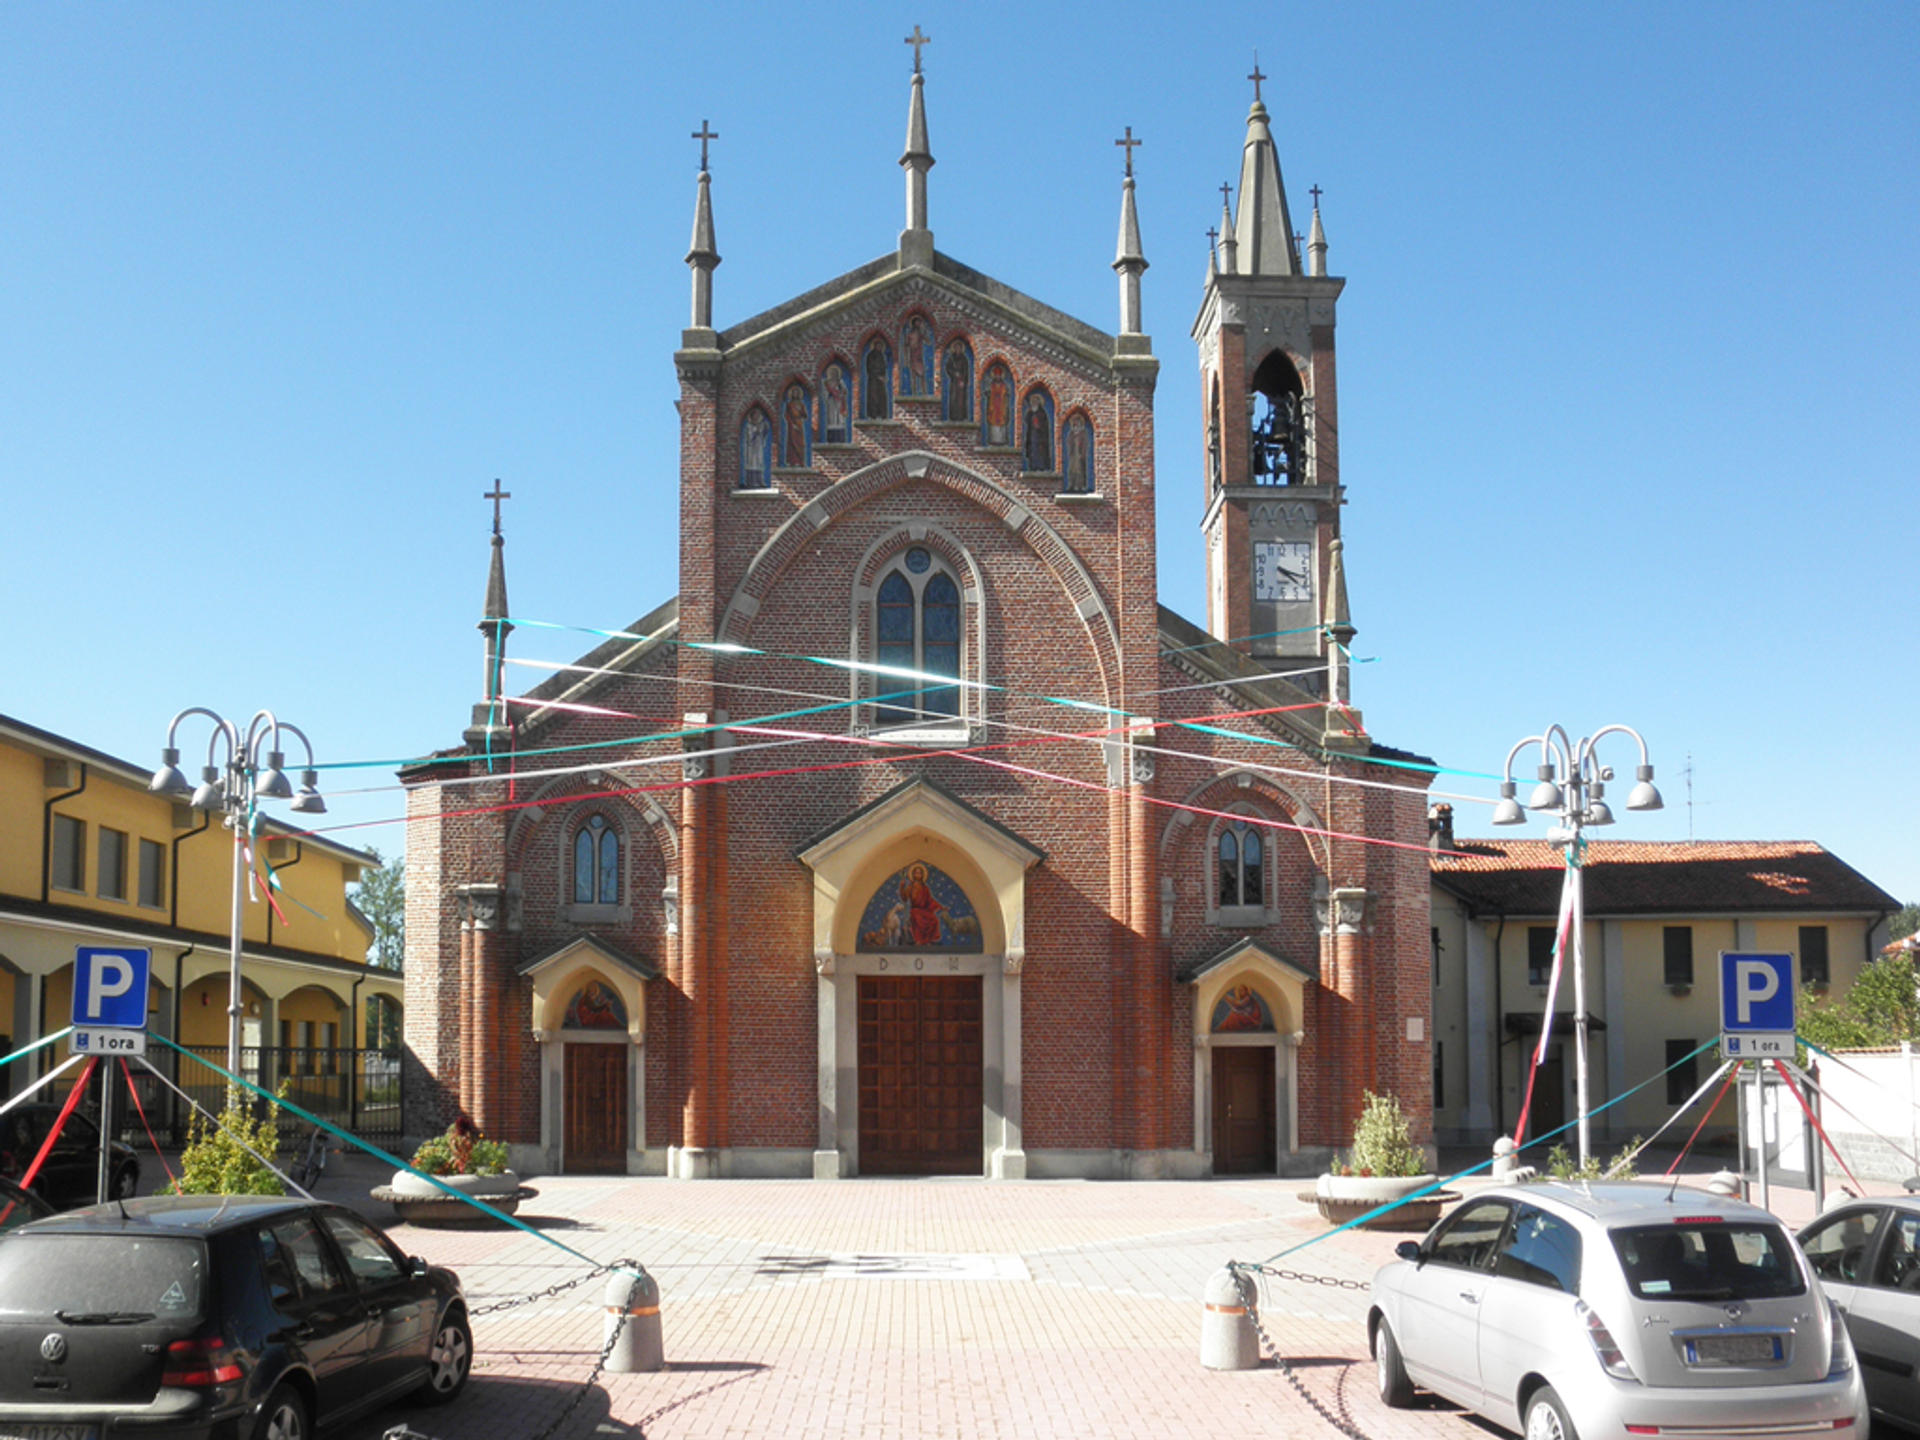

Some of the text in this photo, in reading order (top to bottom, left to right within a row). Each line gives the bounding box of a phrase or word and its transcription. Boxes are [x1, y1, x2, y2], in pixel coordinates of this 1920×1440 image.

[1267, 546, 1274, 556] 11
[1277, 546, 1286, 557] 12
[1258, 554, 1266, 564] 10
[87, 954, 134, 1018] P
[1736, 960, 1779, 1023] P
[99, 1035, 134, 1049] 1 ora
[1751, 1040, 1780, 1051] 1 ora
